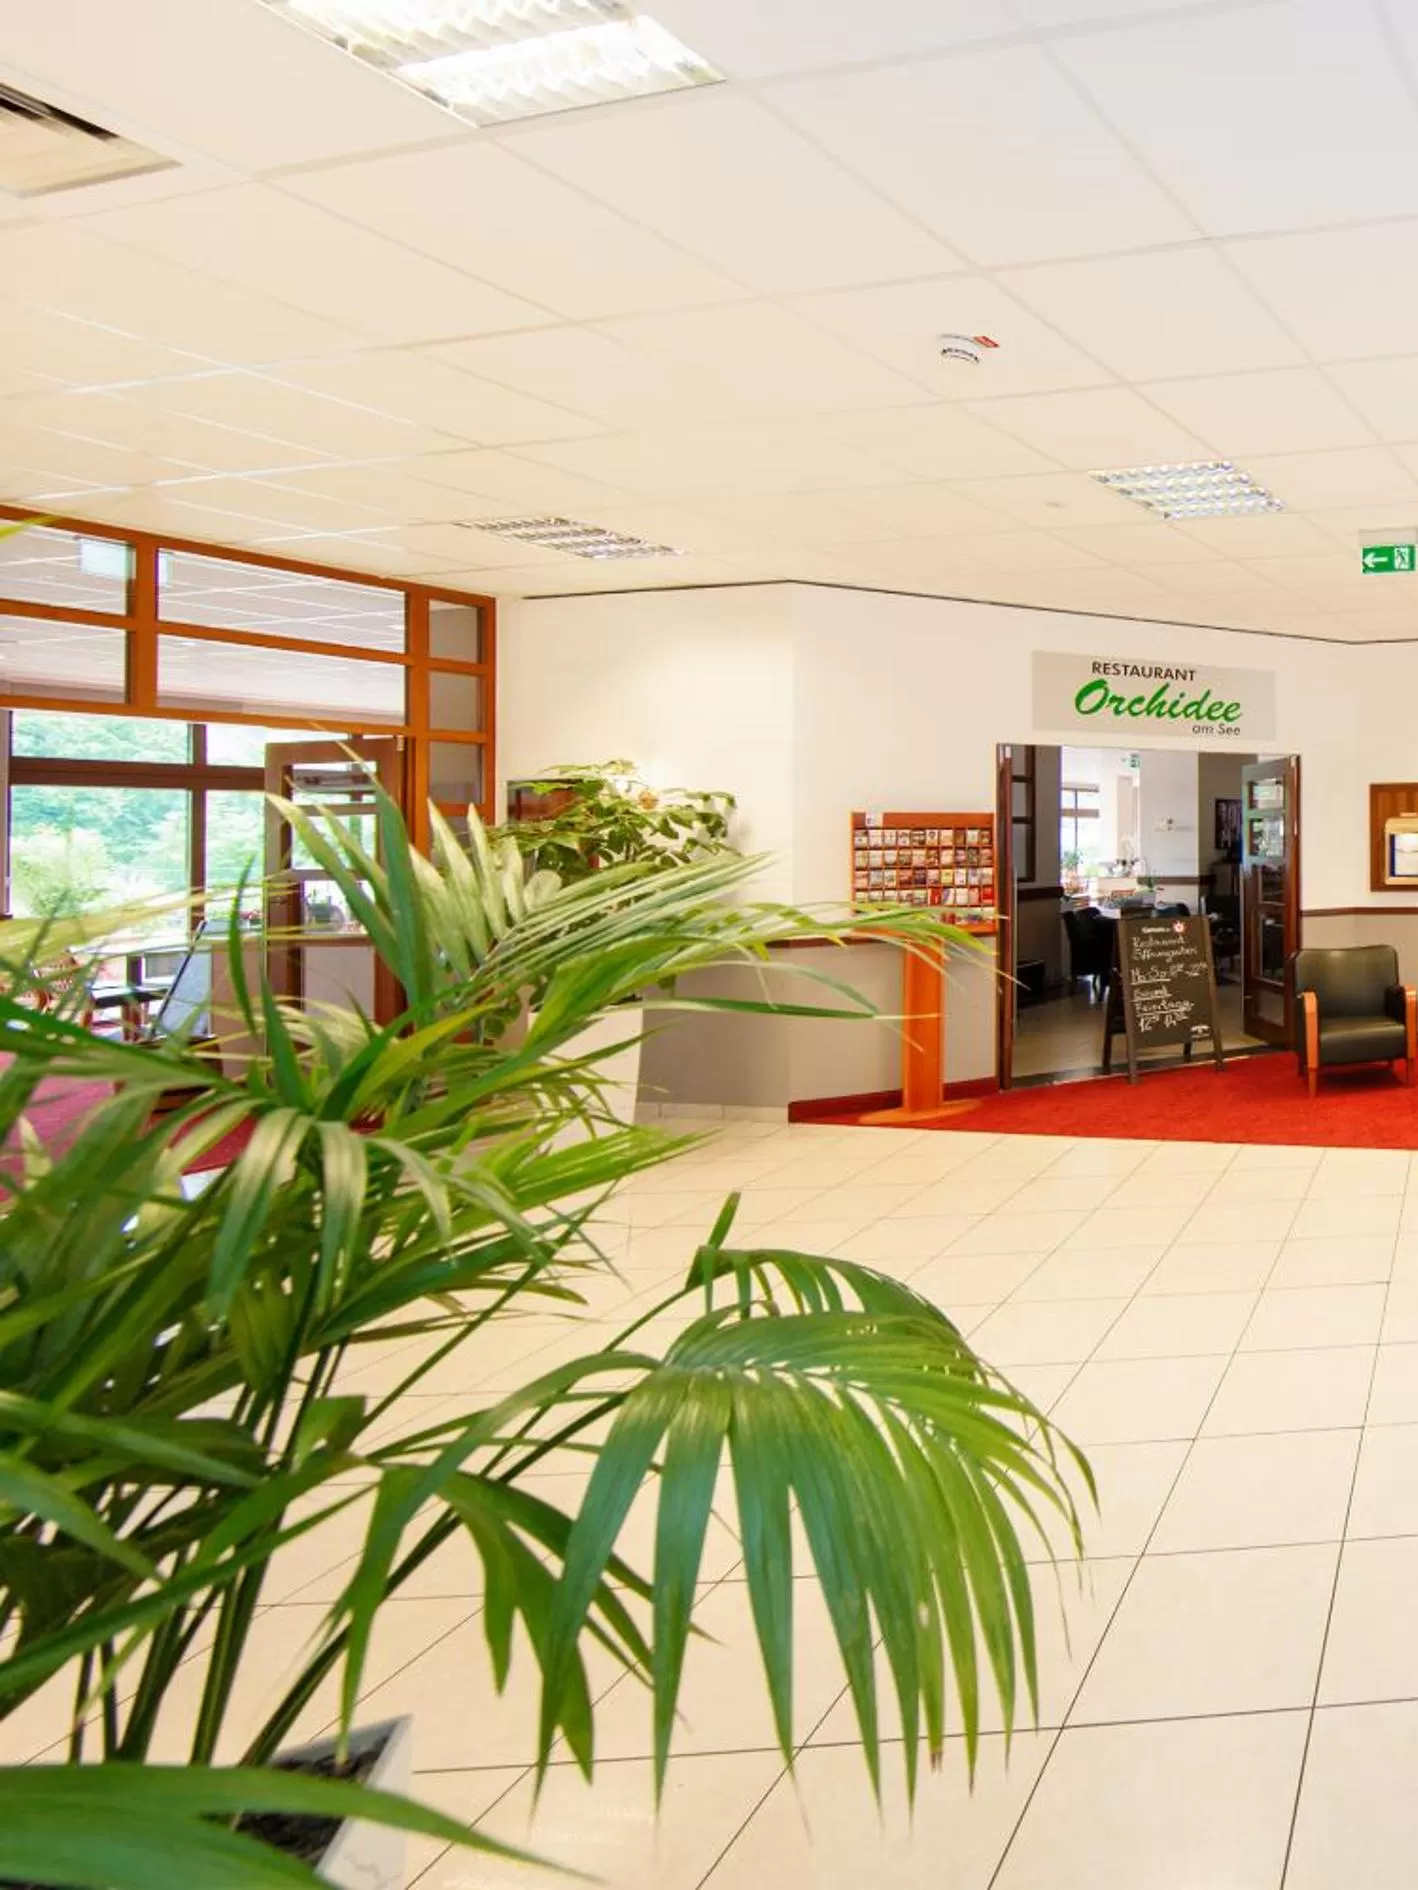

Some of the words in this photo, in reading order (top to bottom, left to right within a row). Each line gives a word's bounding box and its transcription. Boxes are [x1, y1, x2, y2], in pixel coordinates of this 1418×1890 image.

[1091, 661, 1196, 681] RESTAURANT
[1074, 678, 1243, 722] Orchidee
[1192, 724, 1214, 735] am
[1218, 723, 1241, 735] See
